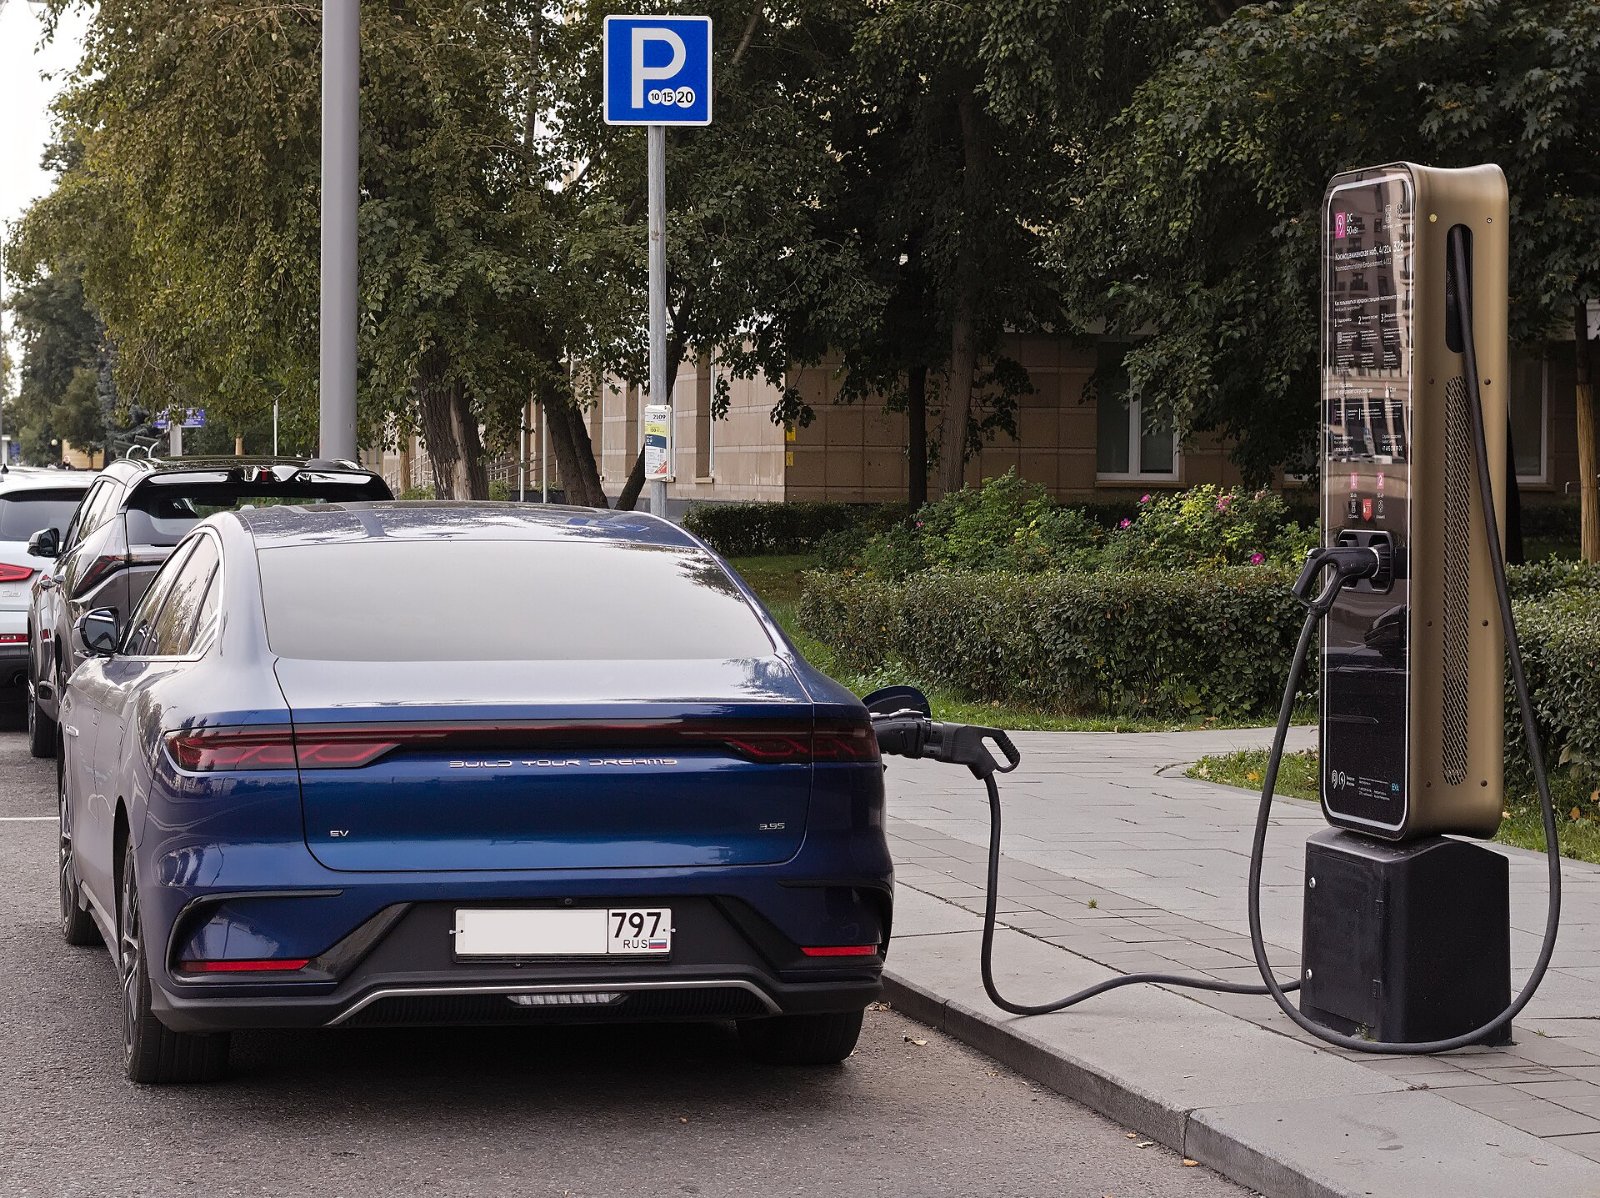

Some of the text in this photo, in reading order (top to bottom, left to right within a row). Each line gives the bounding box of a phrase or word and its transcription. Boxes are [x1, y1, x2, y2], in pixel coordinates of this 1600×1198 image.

[631, 27, 686, 109] P
[662, 92, 673, 102] 15
[677, 91, 694, 103] 20
[450, 758, 678, 768] BUILD YOUR DREAMS
[611, 912, 662, 938] 797
[623, 939, 648, 949] RUS
